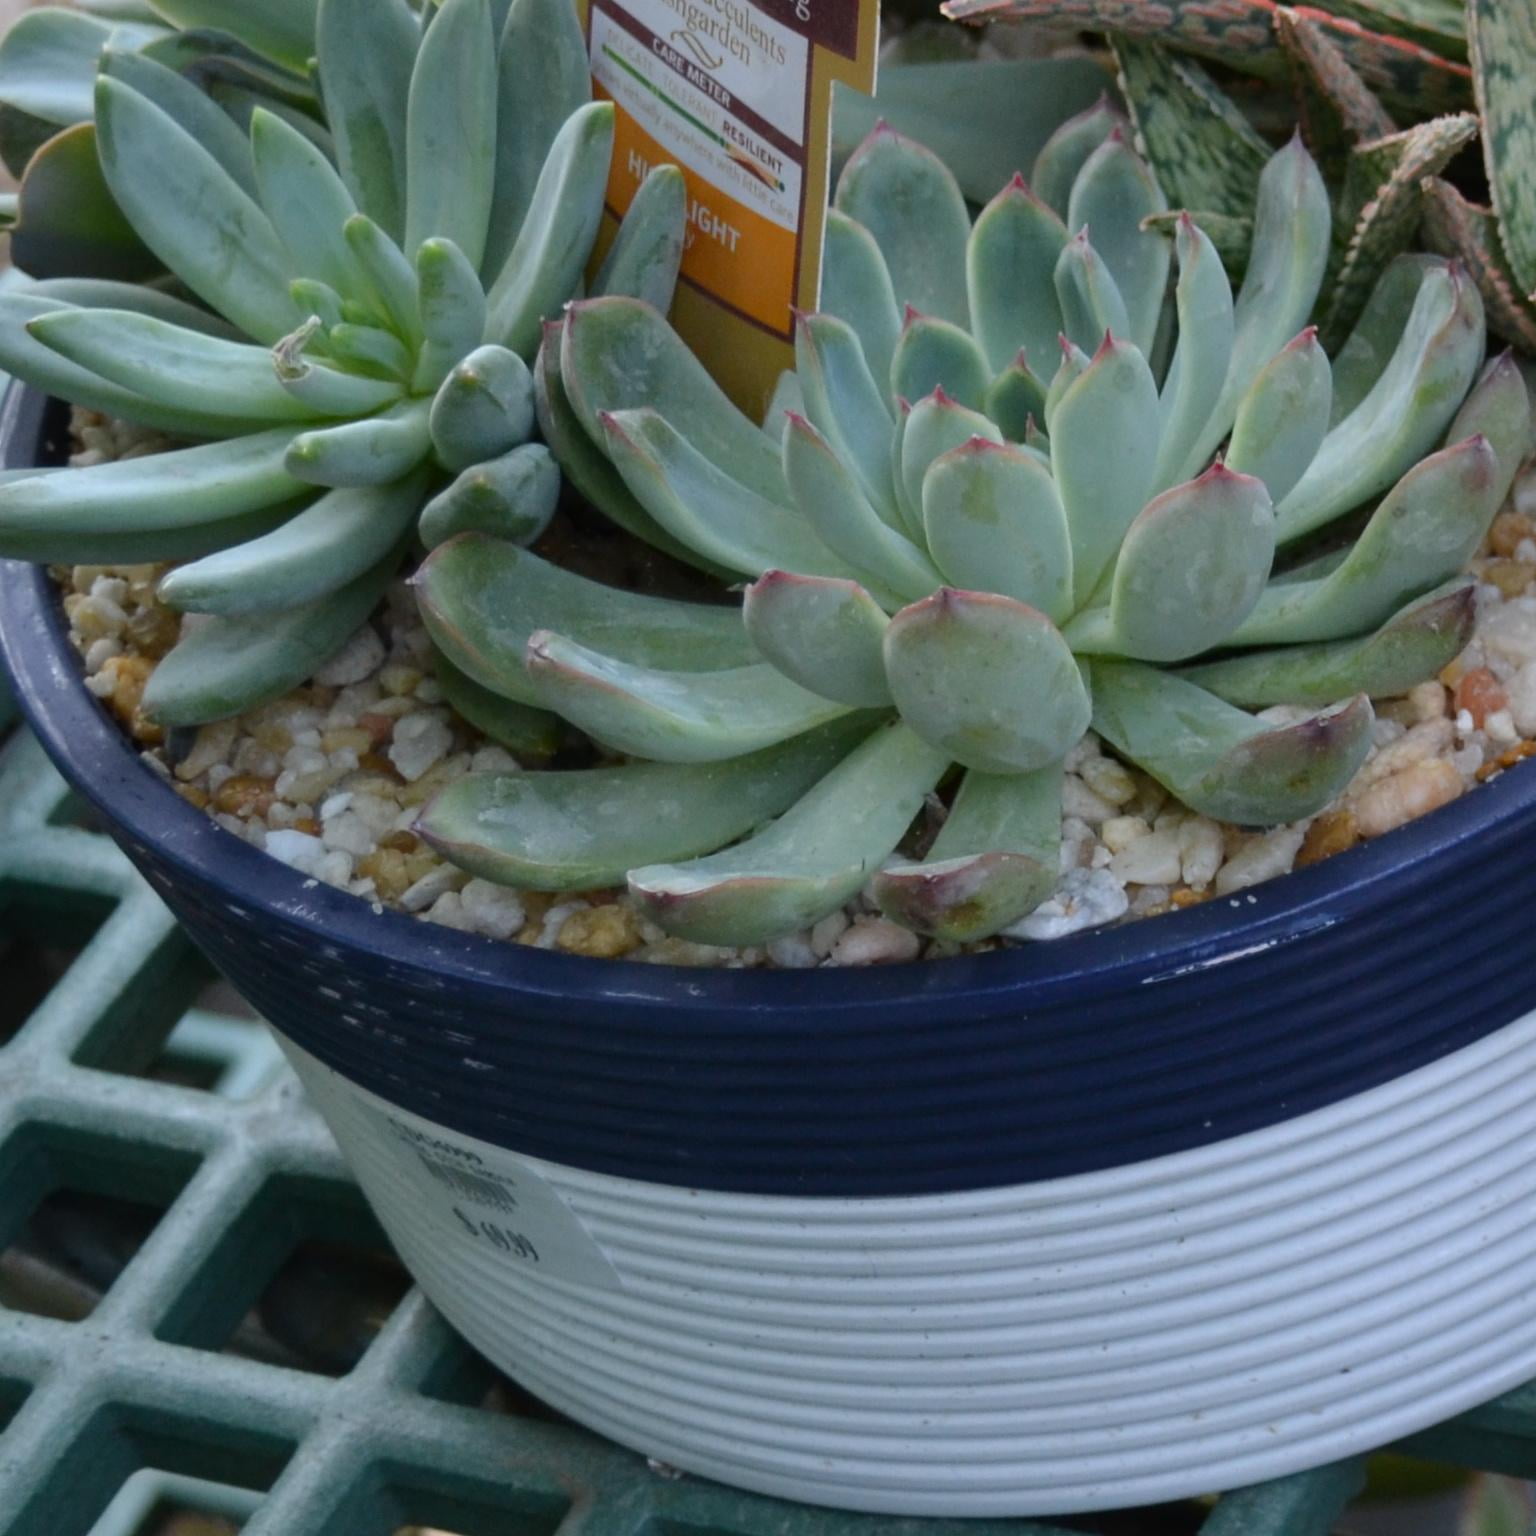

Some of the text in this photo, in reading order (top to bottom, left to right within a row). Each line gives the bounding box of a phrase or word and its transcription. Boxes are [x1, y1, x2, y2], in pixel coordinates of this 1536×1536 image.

[652, 37, 685, 75] CARE
[686, 64, 731, 110] METER
[722, 119, 783, 174] RESILIENT
[688, 199, 742, 253] IGHT
